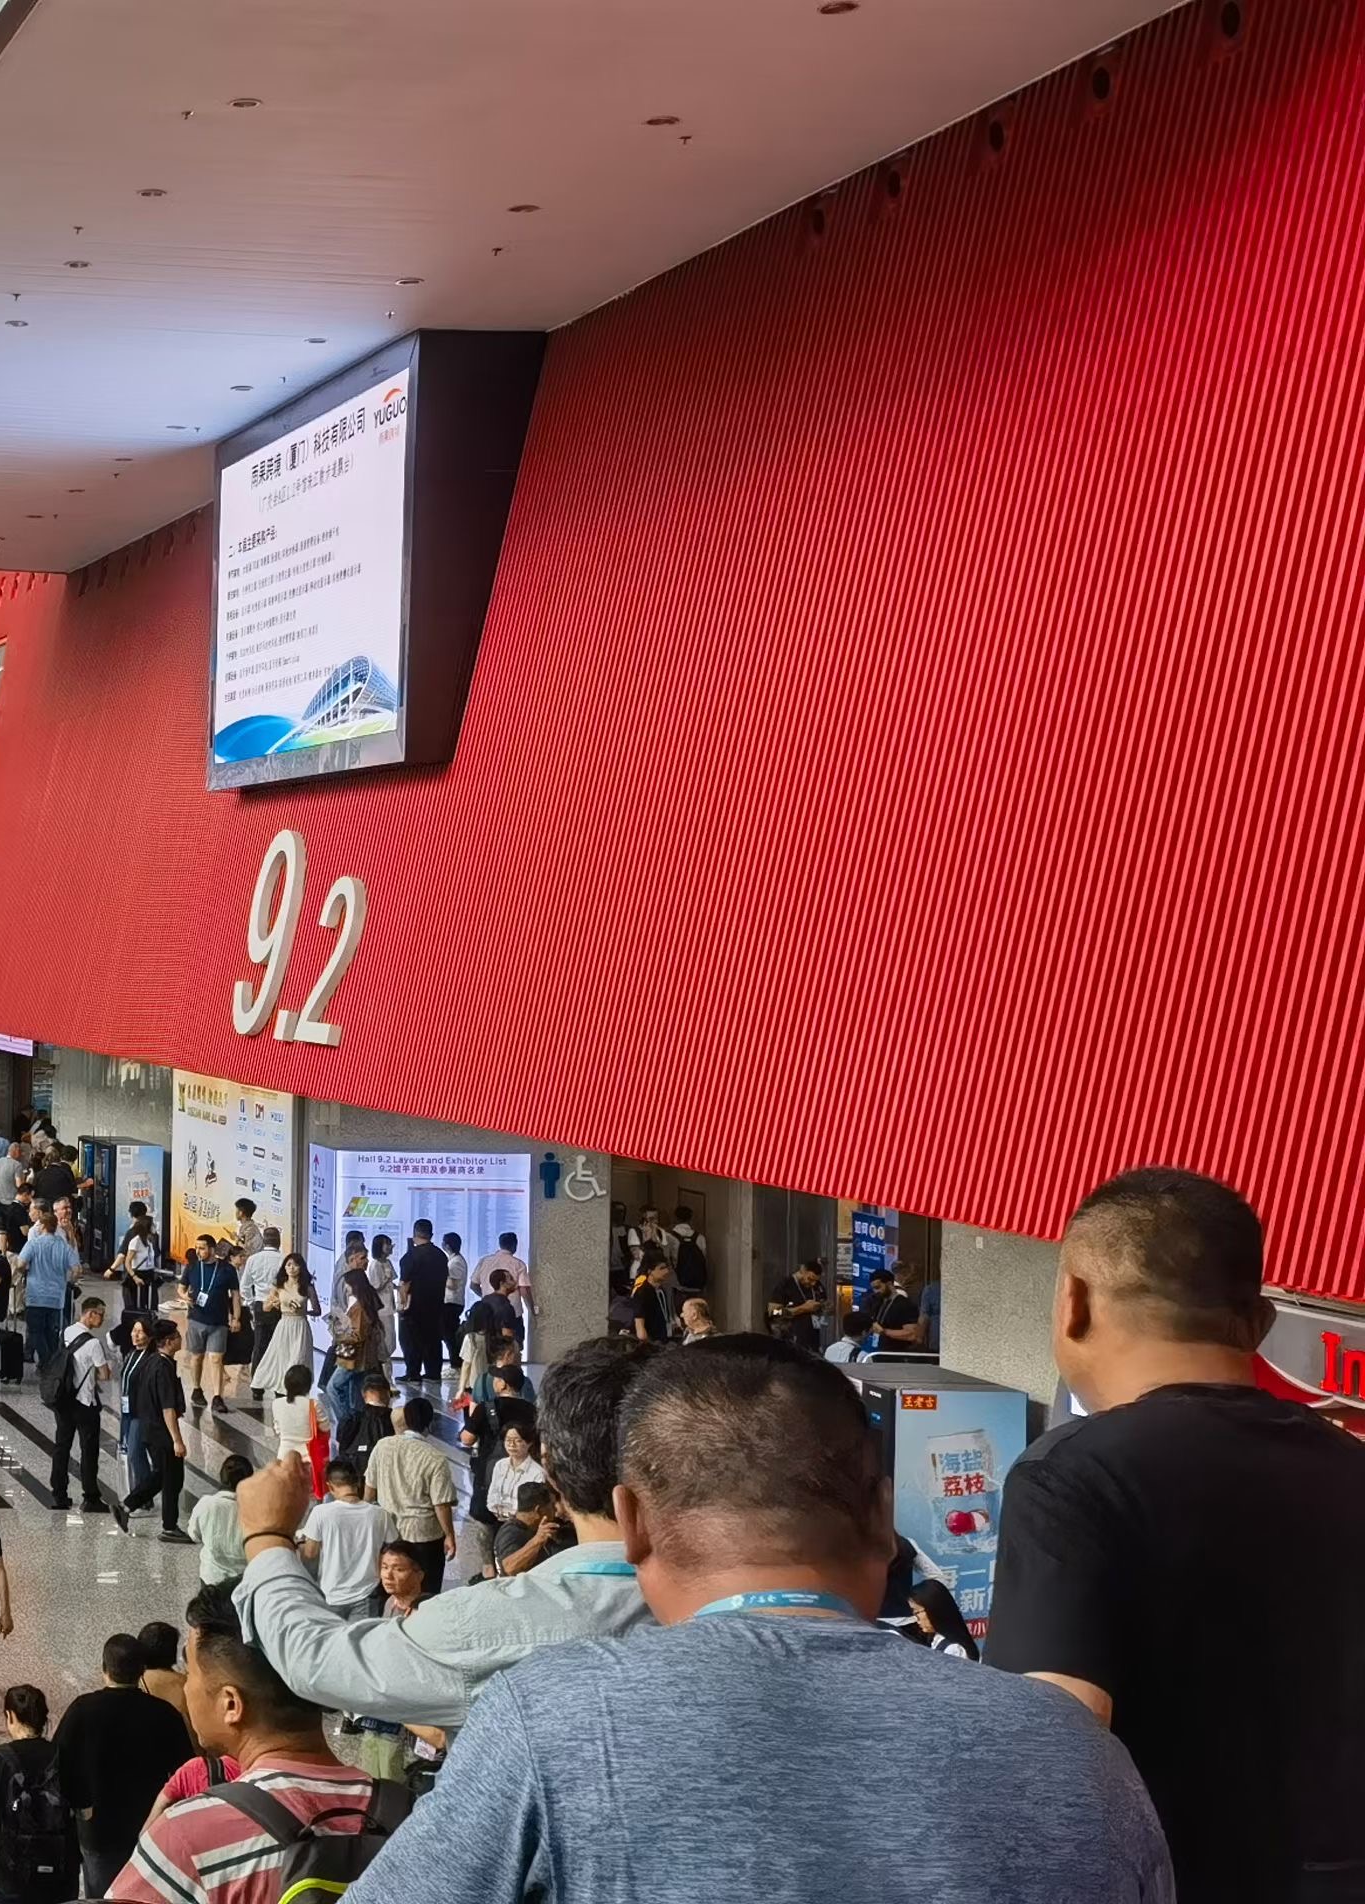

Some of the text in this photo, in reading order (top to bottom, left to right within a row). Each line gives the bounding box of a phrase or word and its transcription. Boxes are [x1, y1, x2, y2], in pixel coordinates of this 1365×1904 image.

[373, 396, 407, 429] YUGUO
[231, 828, 367, 1048] 9.2
[358, 1155, 506, 1166] Hall 9.2 Layout and Exhibitor List
[939, 1450, 984, 1473] 海盐
[942, 1474, 986, 1497] 荔枝
